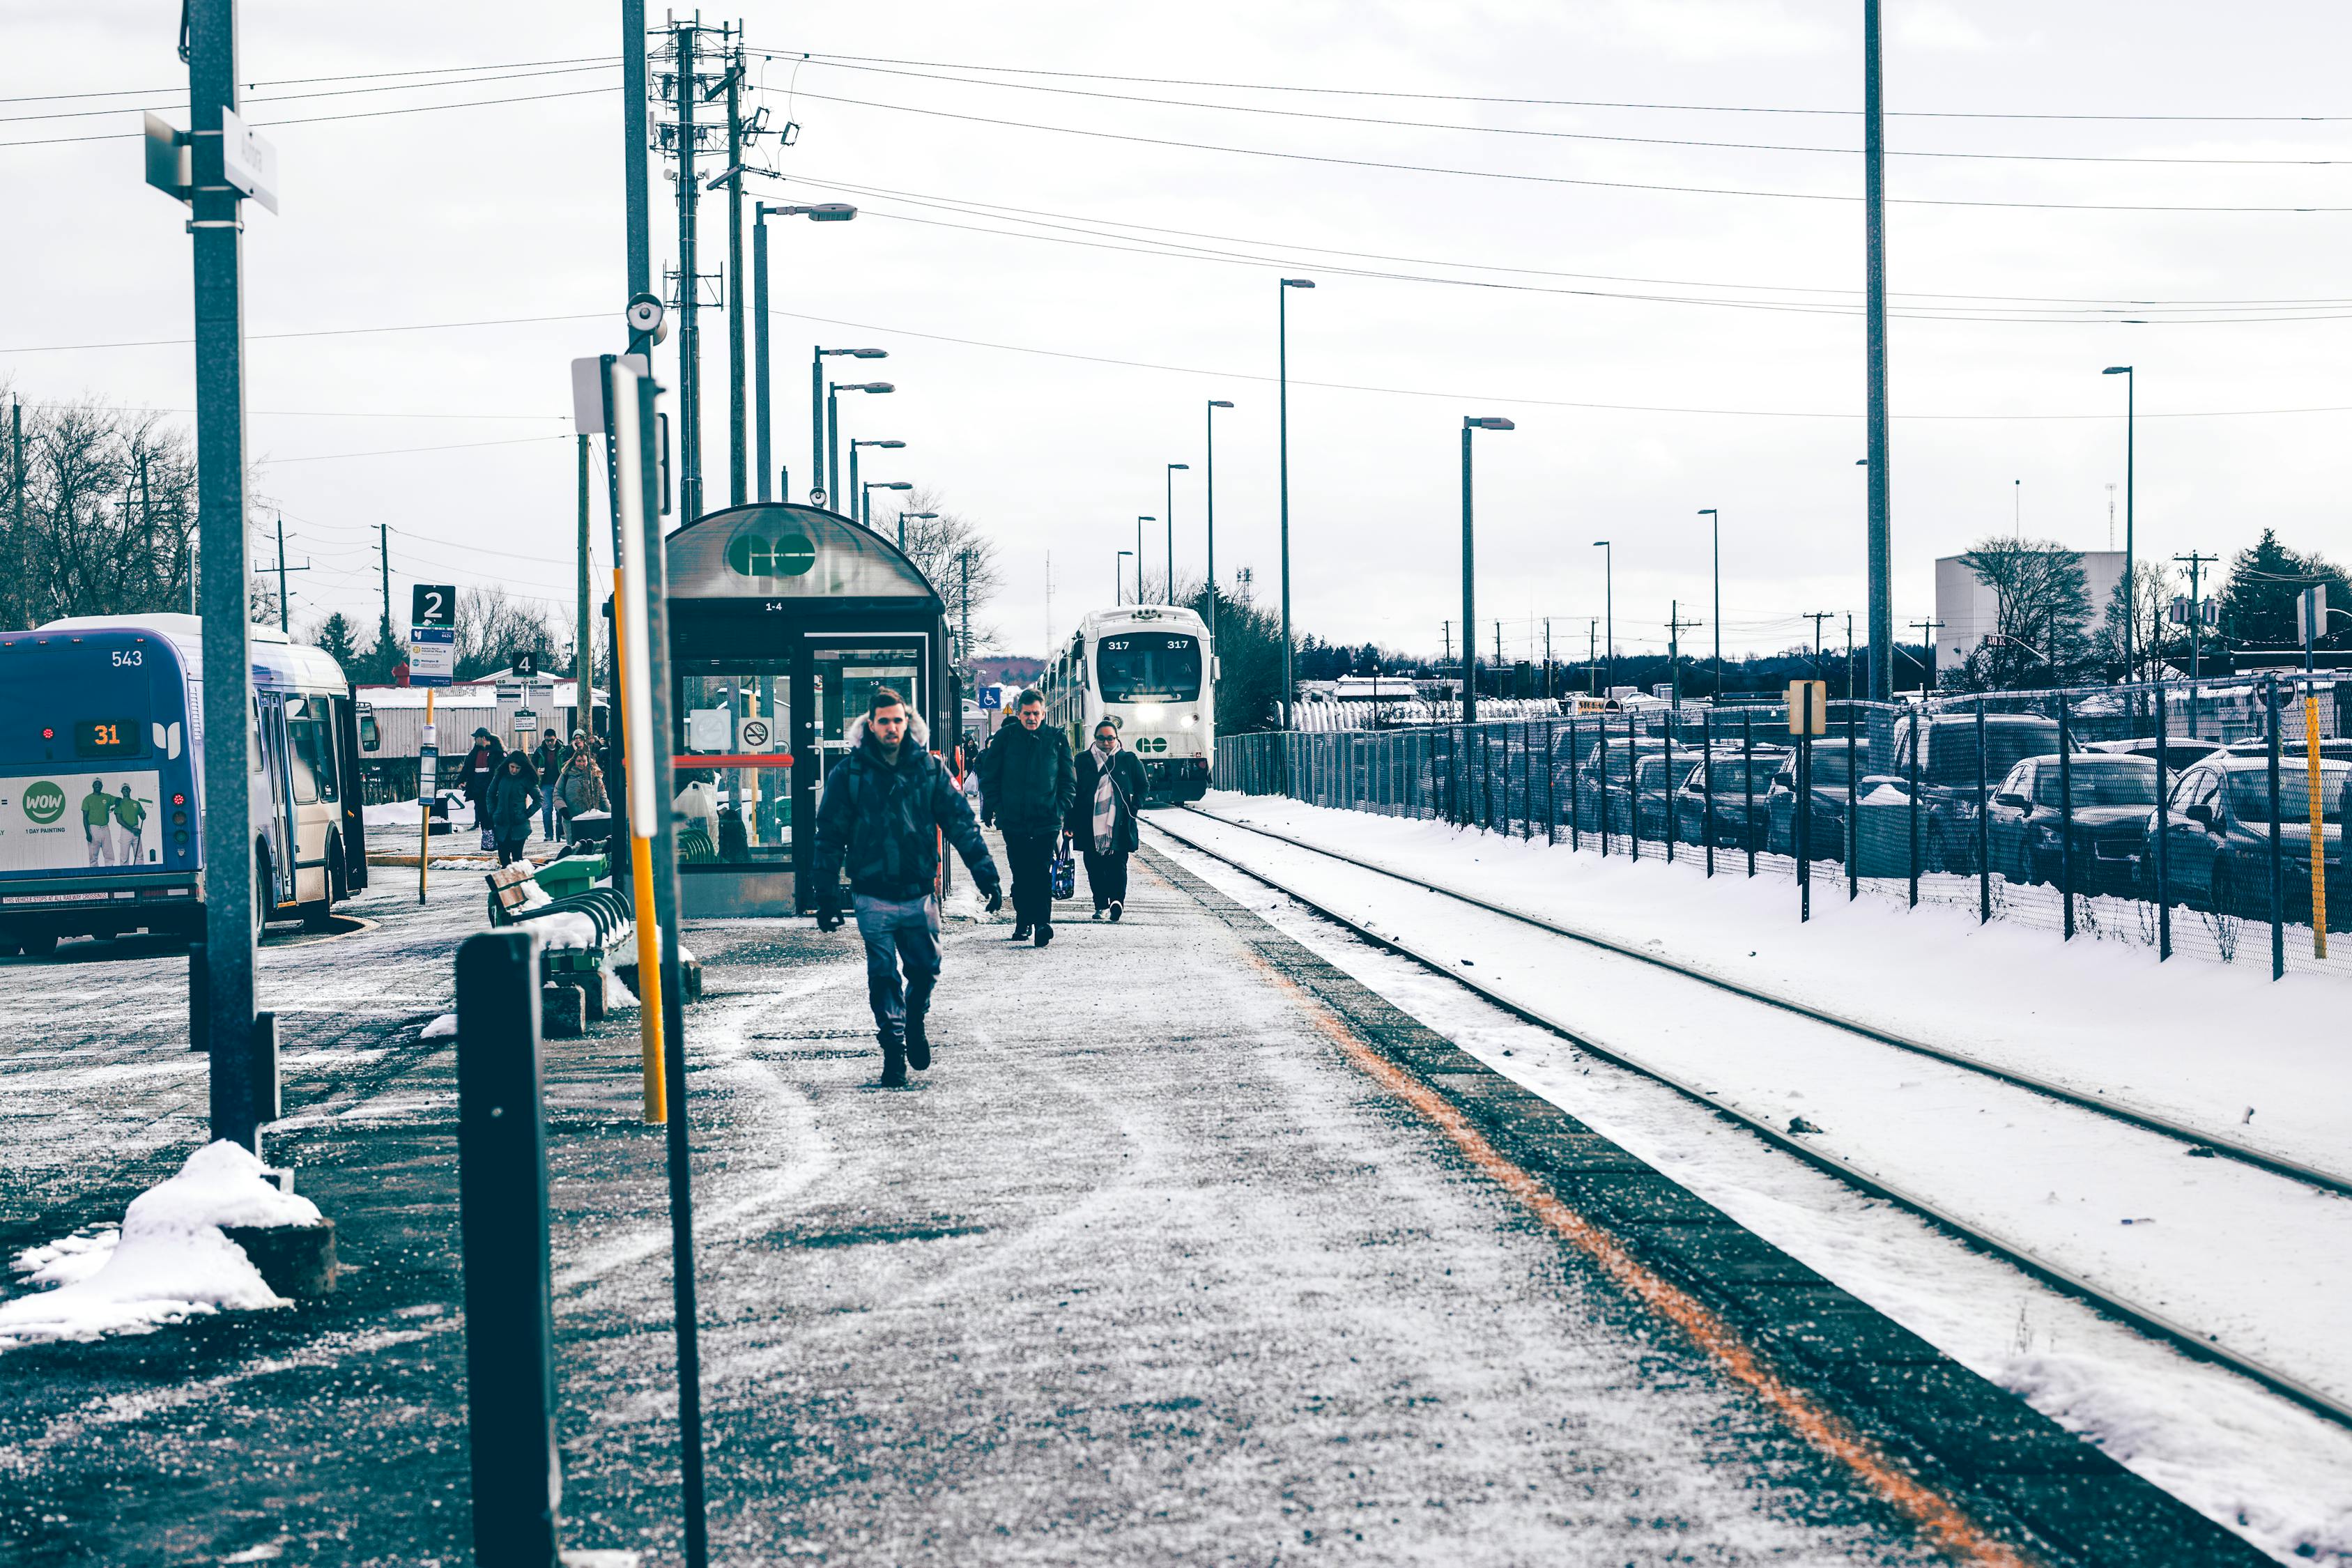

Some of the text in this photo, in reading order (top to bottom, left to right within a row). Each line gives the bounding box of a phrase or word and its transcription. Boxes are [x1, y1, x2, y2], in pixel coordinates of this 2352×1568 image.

[424, 592, 443, 618] 2
[766, 602, 783, 610] 1-4
[1108, 641, 1130, 650] 317
[1167, 640, 1188, 649] 317
[112, 650, 142, 667] 543
[518, 656, 531, 672] 4
[95, 725, 120, 744] 31
[1136, 737, 1167, 753] GO
[26, 794, 62, 809] WOW
